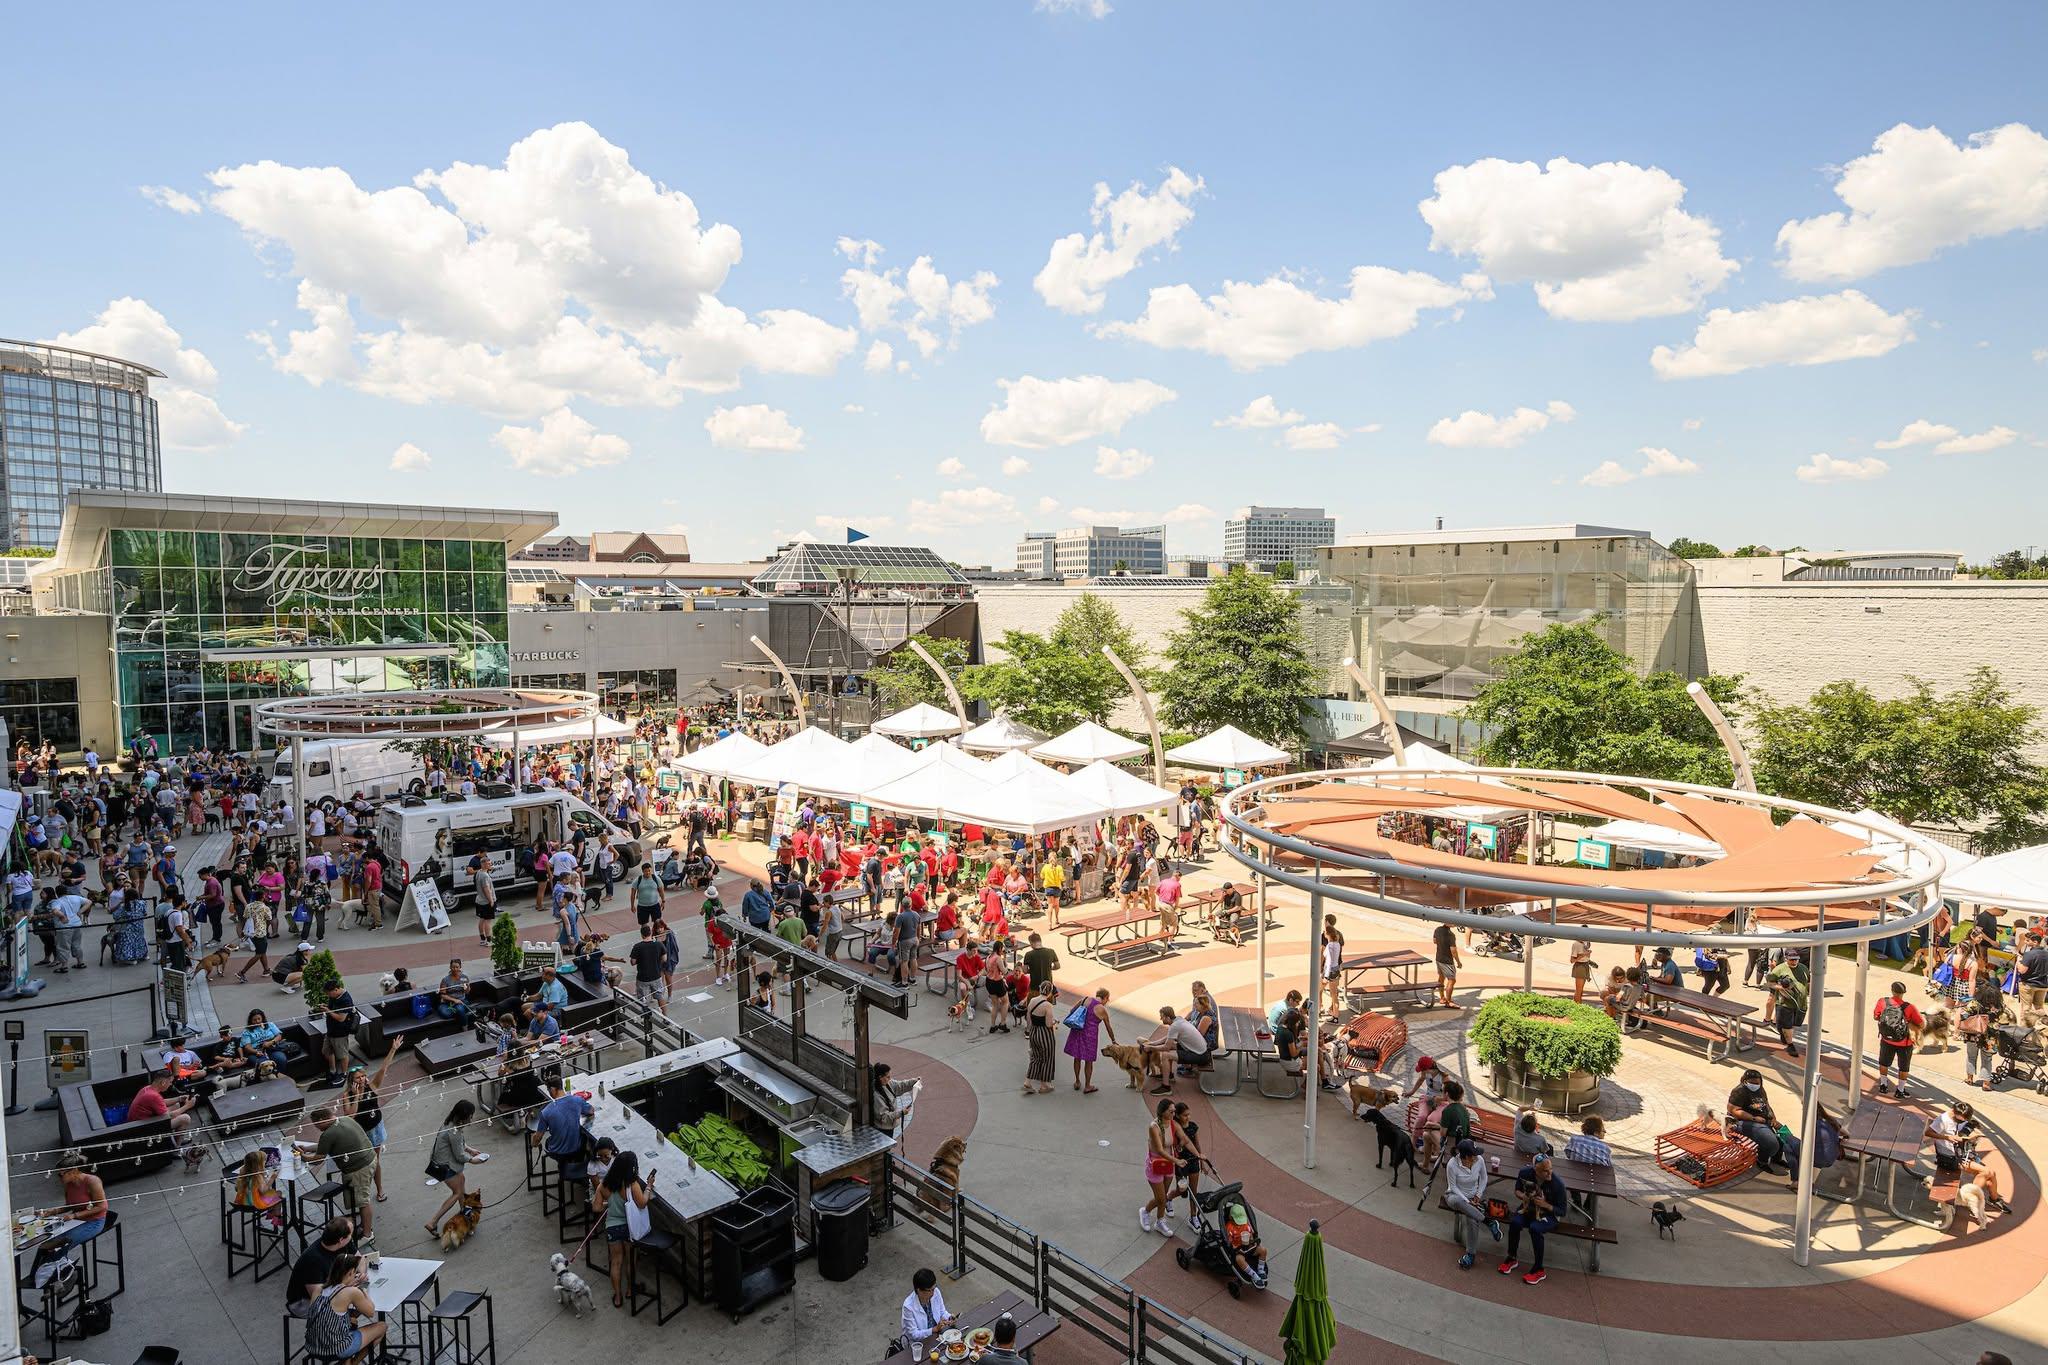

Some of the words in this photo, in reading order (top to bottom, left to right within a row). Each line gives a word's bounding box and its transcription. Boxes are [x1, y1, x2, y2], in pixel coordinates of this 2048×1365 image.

[233, 543, 380, 607] Tysons
[290, 606, 354, 617] CORNER
[360, 606, 420, 617] CENTER
[1341, 712, 1366, 722] HERE
